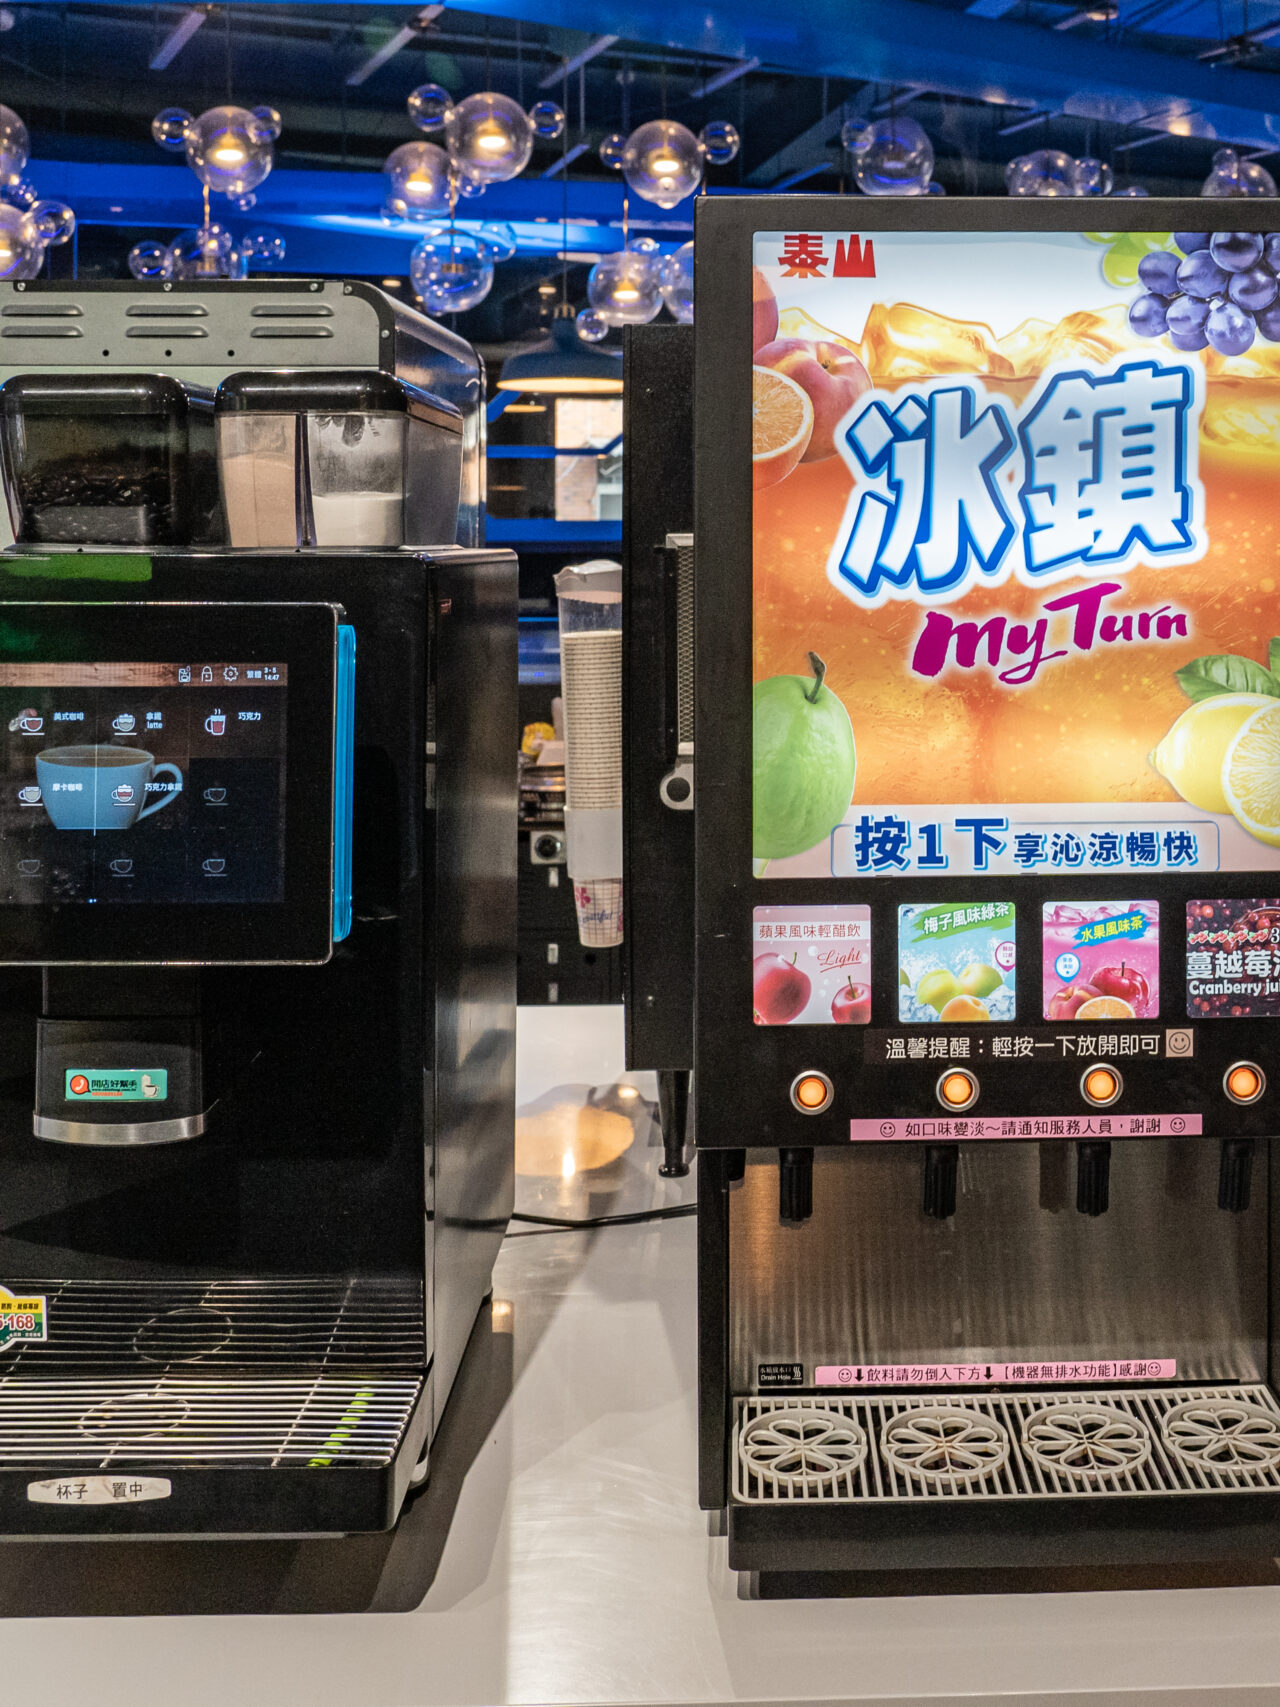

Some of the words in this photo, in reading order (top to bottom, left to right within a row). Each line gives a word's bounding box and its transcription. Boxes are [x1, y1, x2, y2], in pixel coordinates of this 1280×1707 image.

[778, 234, 876, 278] 泰山
[838, 358, 1196, 596] 冰鎮
[1044, 582, 1188, 650] Turn
[146, 721, 163, 729] latte
[238, 711, 261, 721] 巧克力
[923, 902, 1010, 935] 梅子風味綠茶
[1080, 914, 1144, 943] 水果風味茶
[759, 923, 861, 939] 蘋果風味輕醋飲
[816, 946, 862, 970] Light
[1189, 979, 1264, 997] Cranberry
[56, 1483, 88, 1500] 杯子
[112, 1481, 142, 1498] 置中
